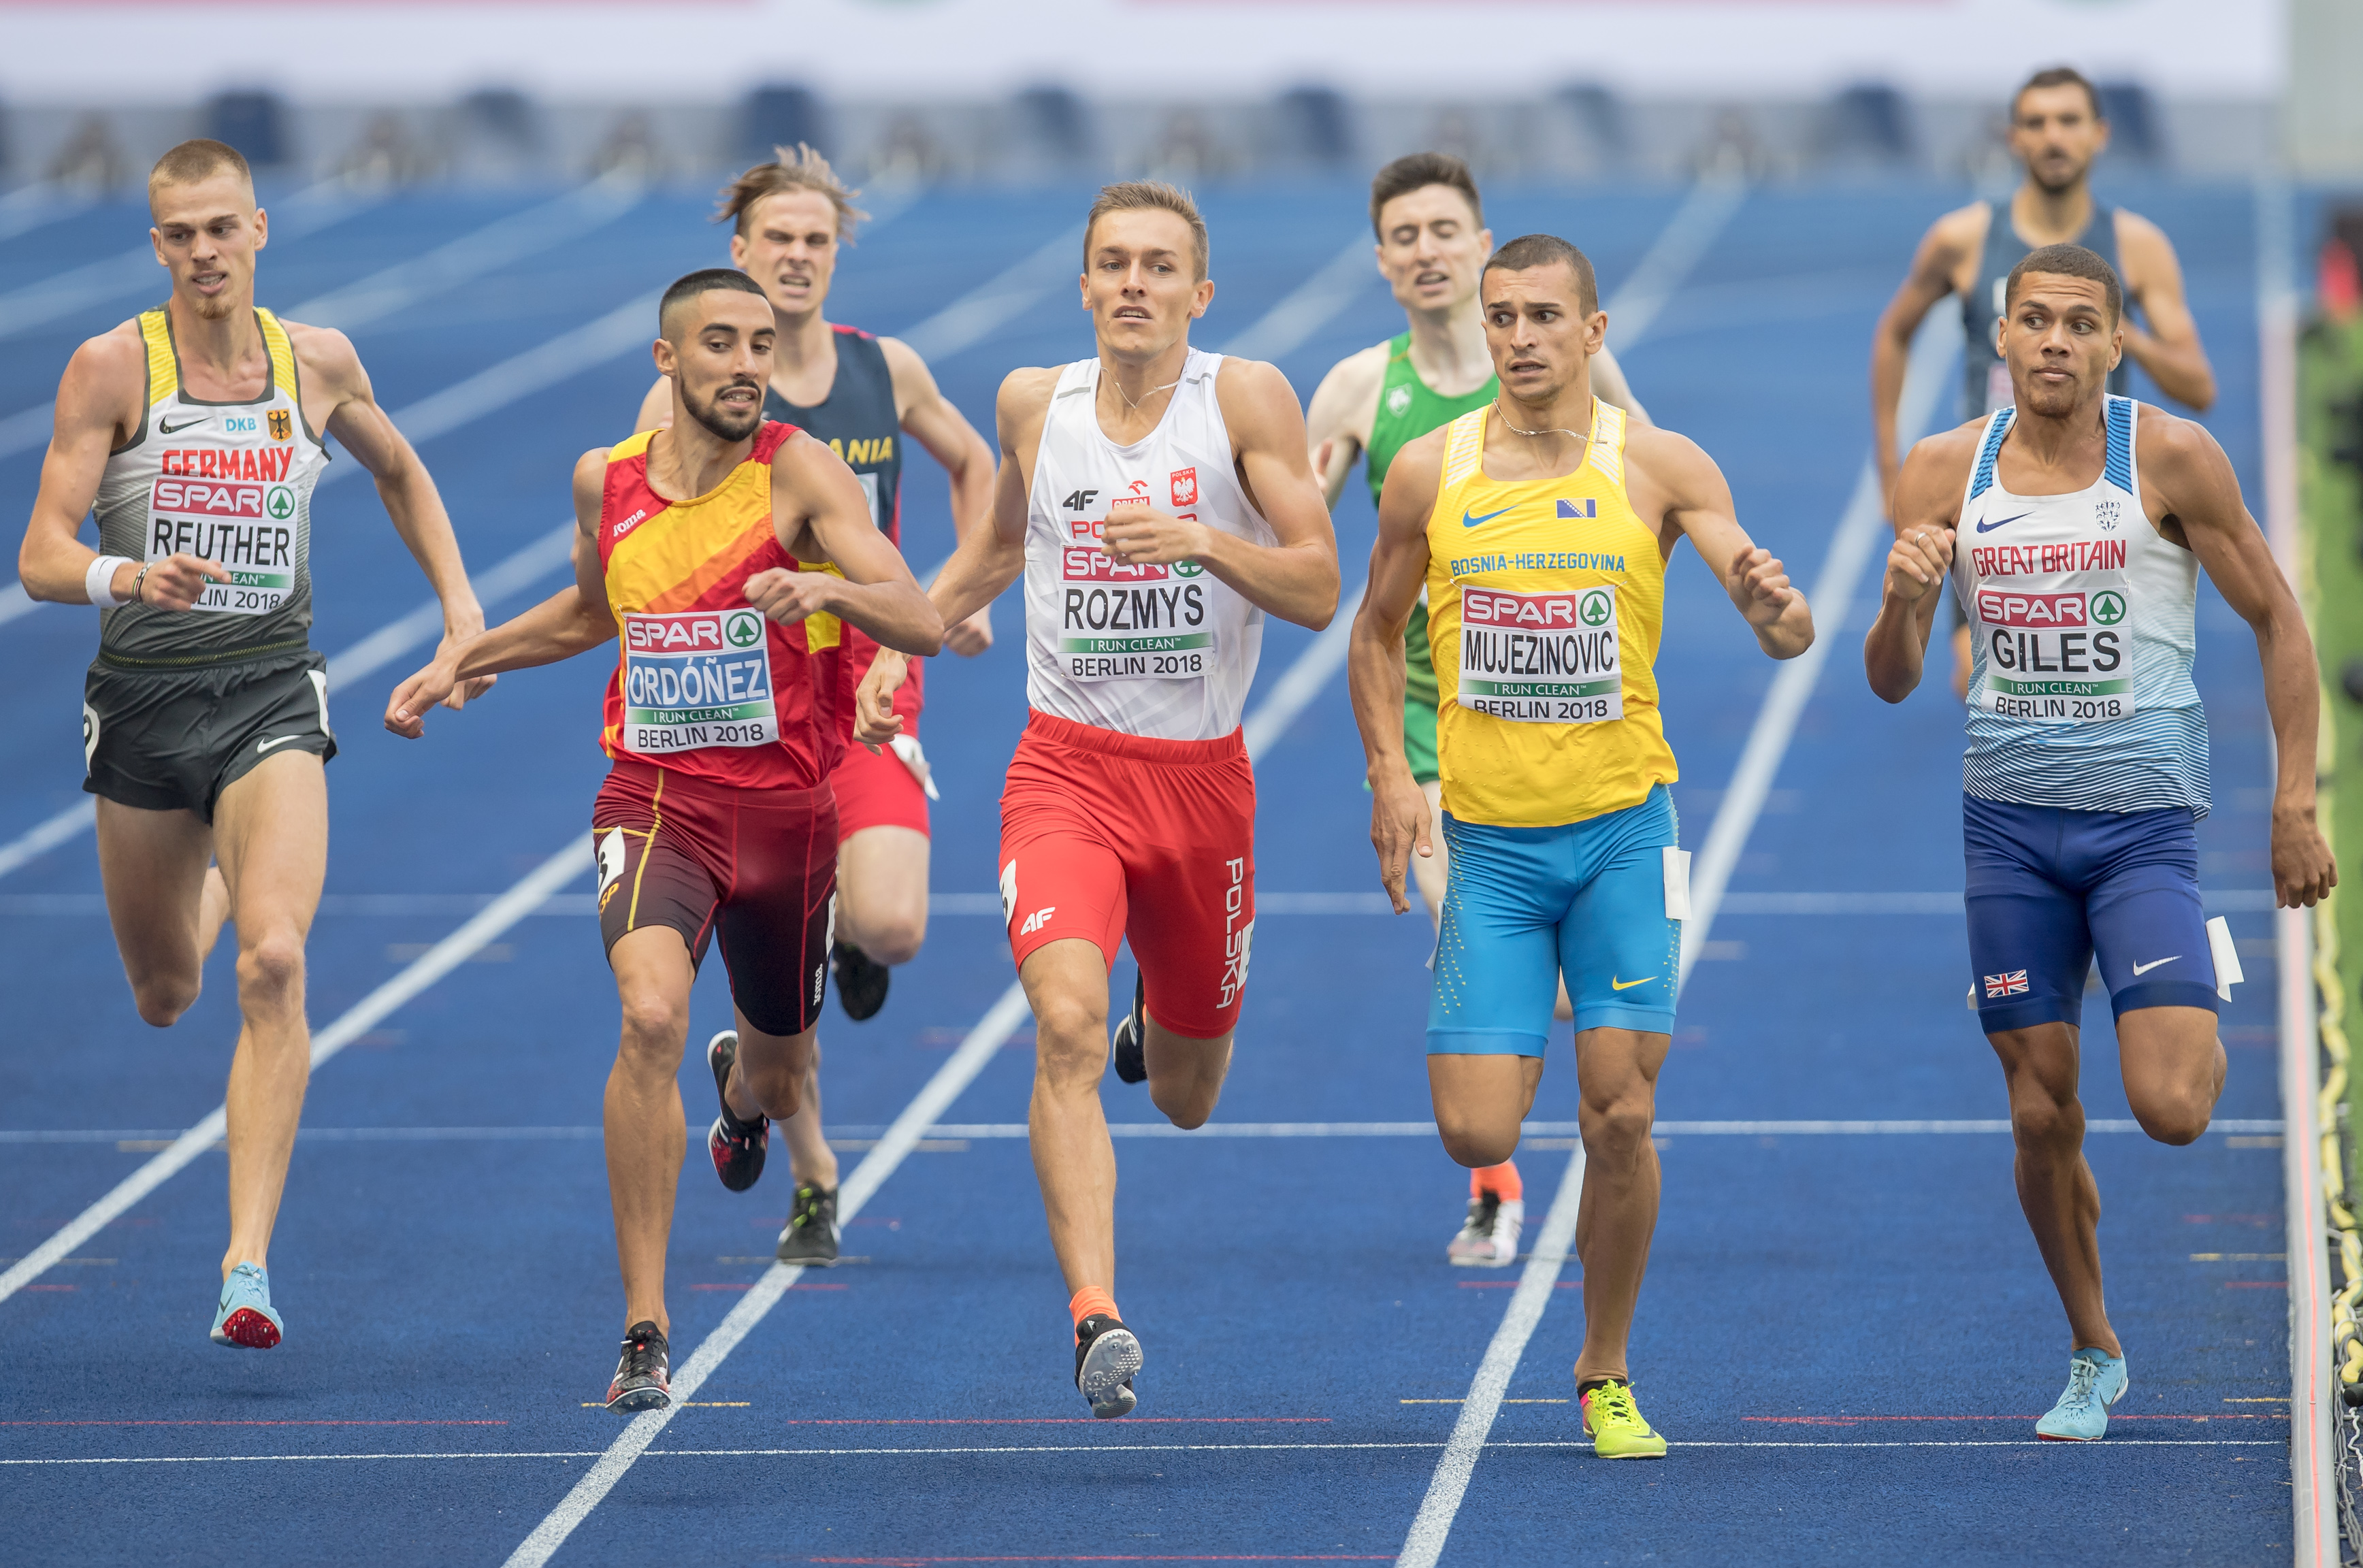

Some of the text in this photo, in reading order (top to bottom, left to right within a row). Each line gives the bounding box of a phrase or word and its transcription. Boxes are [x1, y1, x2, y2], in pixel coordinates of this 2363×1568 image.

[226, 418, 257, 431] DKB
[828, 436, 892, 464] ANIA
[162, 446, 294, 482] GERMANY
[1172, 469, 1194, 478] POLSKA
[157, 483, 261, 513] SPAR
[1062, 490, 1098, 510] 4F
[153, 518, 289, 566] REUTHER
[1450, 553, 1625, 576] BOSNIA-HERZEGOVINA
[1972, 540, 2126, 577] GREAT BRITAIN
[234, 591, 280, 610] 2018
[1064, 584, 1203, 630] ROZMYS
[1467, 594, 1574, 625] SPAR
[1981, 595, 2083, 622] SPAR
[628, 621, 719, 648] SPAR
[1090, 641, 1094, 651] I
[1098, 640, 1126, 651] RUN
[1465, 630, 1614, 675] MUJEZINOVIC
[1991, 628, 2121, 672] GILES
[1072, 653, 1202, 676] BERLIN 2018
[629, 657, 766, 705] ORDÓÑEZ
[1494, 683, 1497, 694] I
[1502, 684, 1531, 695] RUN
[2011, 682, 2014, 693] I
[2017, 683, 2046, 693] RUN
[653, 711, 657, 723] I
[659, 710, 685, 723] RUN
[1474, 699, 1608, 719] BERLIN 2018
[1995, 696, 2121, 719] BERLIN 2018
[638, 723, 764, 748] BERLIN 2018
[1020, 906, 1056, 936] 4F
[1216, 857, 1243, 1009] POLSKA
